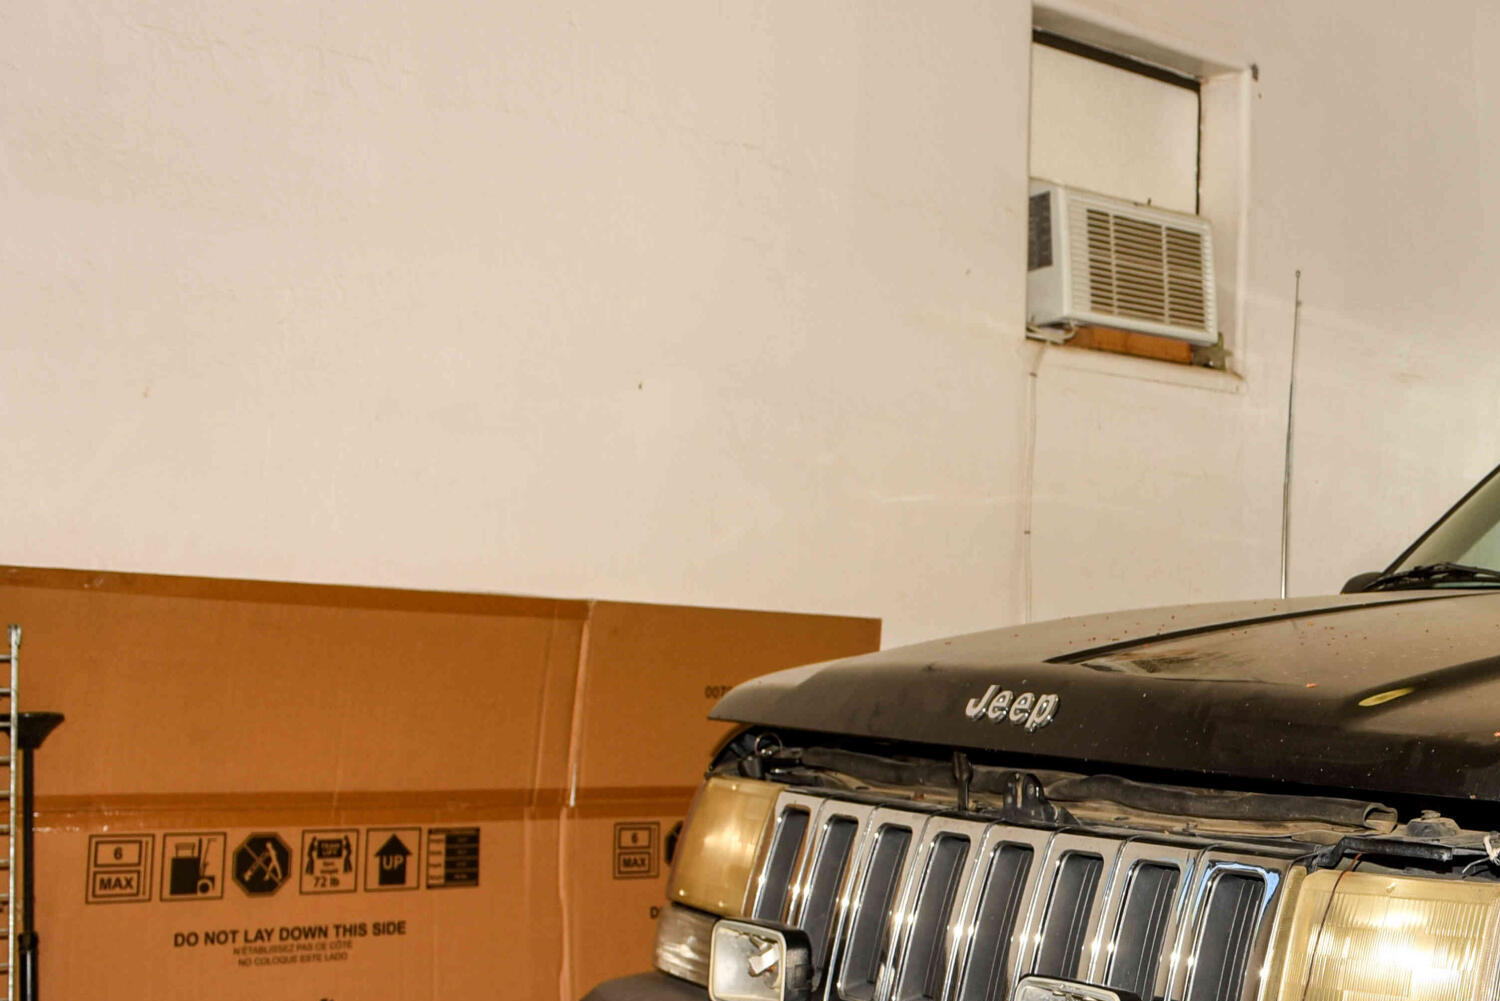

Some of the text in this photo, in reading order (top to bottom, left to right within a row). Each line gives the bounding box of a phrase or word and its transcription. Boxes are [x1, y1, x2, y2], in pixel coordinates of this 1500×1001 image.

[965, 684, 1059, 732] Jeep
[631, 832, 639, 844] 6
[113, 847, 123, 860] 6
[382, 854, 404, 871] UP
[622, 857, 647, 868] MAX
[99, 876, 133, 891] MAX
[313, 876, 326, 888] 72
[174, 920, 407, 947] DO NOT LAY DOWN THIS SIDE
[238, 956, 252, 967] NO
